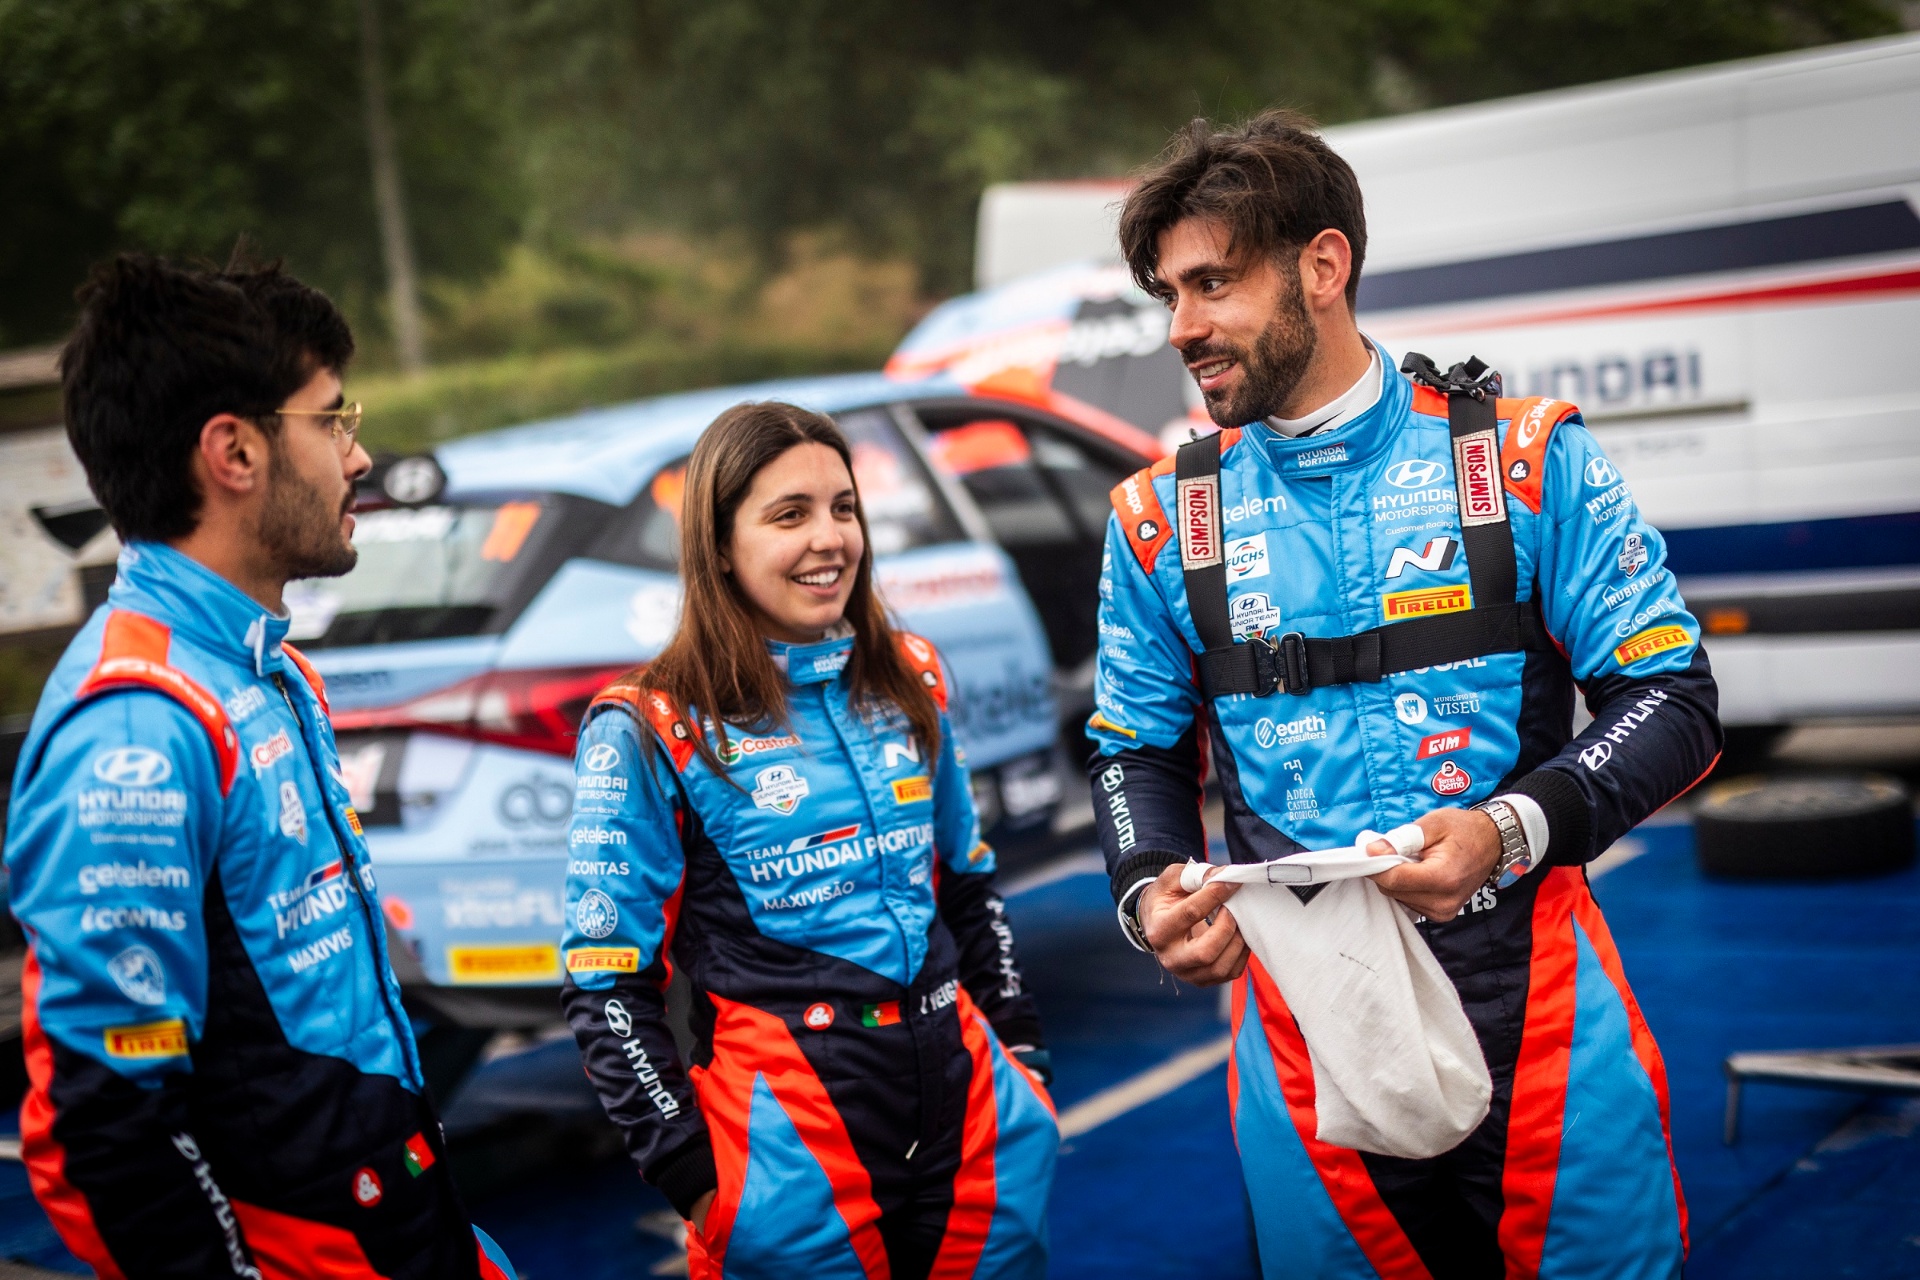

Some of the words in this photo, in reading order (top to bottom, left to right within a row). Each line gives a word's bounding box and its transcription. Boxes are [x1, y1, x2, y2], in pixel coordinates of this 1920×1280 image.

[1298, 446, 1346, 461] HYUNDAI
[1298, 454, 1349, 468] PORTUGAL
[1466, 443, 1492, 512] SIMPSON
[1373, 488, 1458, 510] HYUNDAI
[1585, 482, 1633, 515] HYUND
[1222, 495, 1287, 525] telem
[1375, 503, 1459, 523] MOTORSPORT
[1594, 496, 1633, 526] MOTORSP
[1189, 488, 1209, 556] SIMPSON
[1385, 523, 1425, 536] Customer
[1426, 520, 1454, 531] Racing
[1226, 549, 1265, 569] FUCHS
[1236, 607, 1265, 619] HYUNDAI
[1388, 590, 1465, 616] PIRELLI
[1255, 612, 1278, 622] TEAM
[1618, 628, 1688, 663] PIRELLI
[1434, 699, 1480, 717] VISEU
[1276, 714, 1326, 737] earth
[742, 733, 800, 754] Castrol
[1278, 731, 1327, 746] consulters
[576, 776, 628, 791] HYUNDAI
[1438, 780, 1465, 792] Demo
[78, 789, 188, 812] HYUNDAI
[1286, 788, 1316, 801] ADEGA
[1287, 799, 1318, 811] CASTELO
[1289, 809, 1320, 822] RODRIGO
[745, 844, 783, 861] TEAM
[750, 840, 863, 883] HYUNDAI
[763, 880, 855, 911] MAXIVISÃO
[287, 924, 354, 974] MAXIVIS
[569, 952, 634, 969] PIRELLI
[622, 1038, 680, 1120] HYUNDAI
